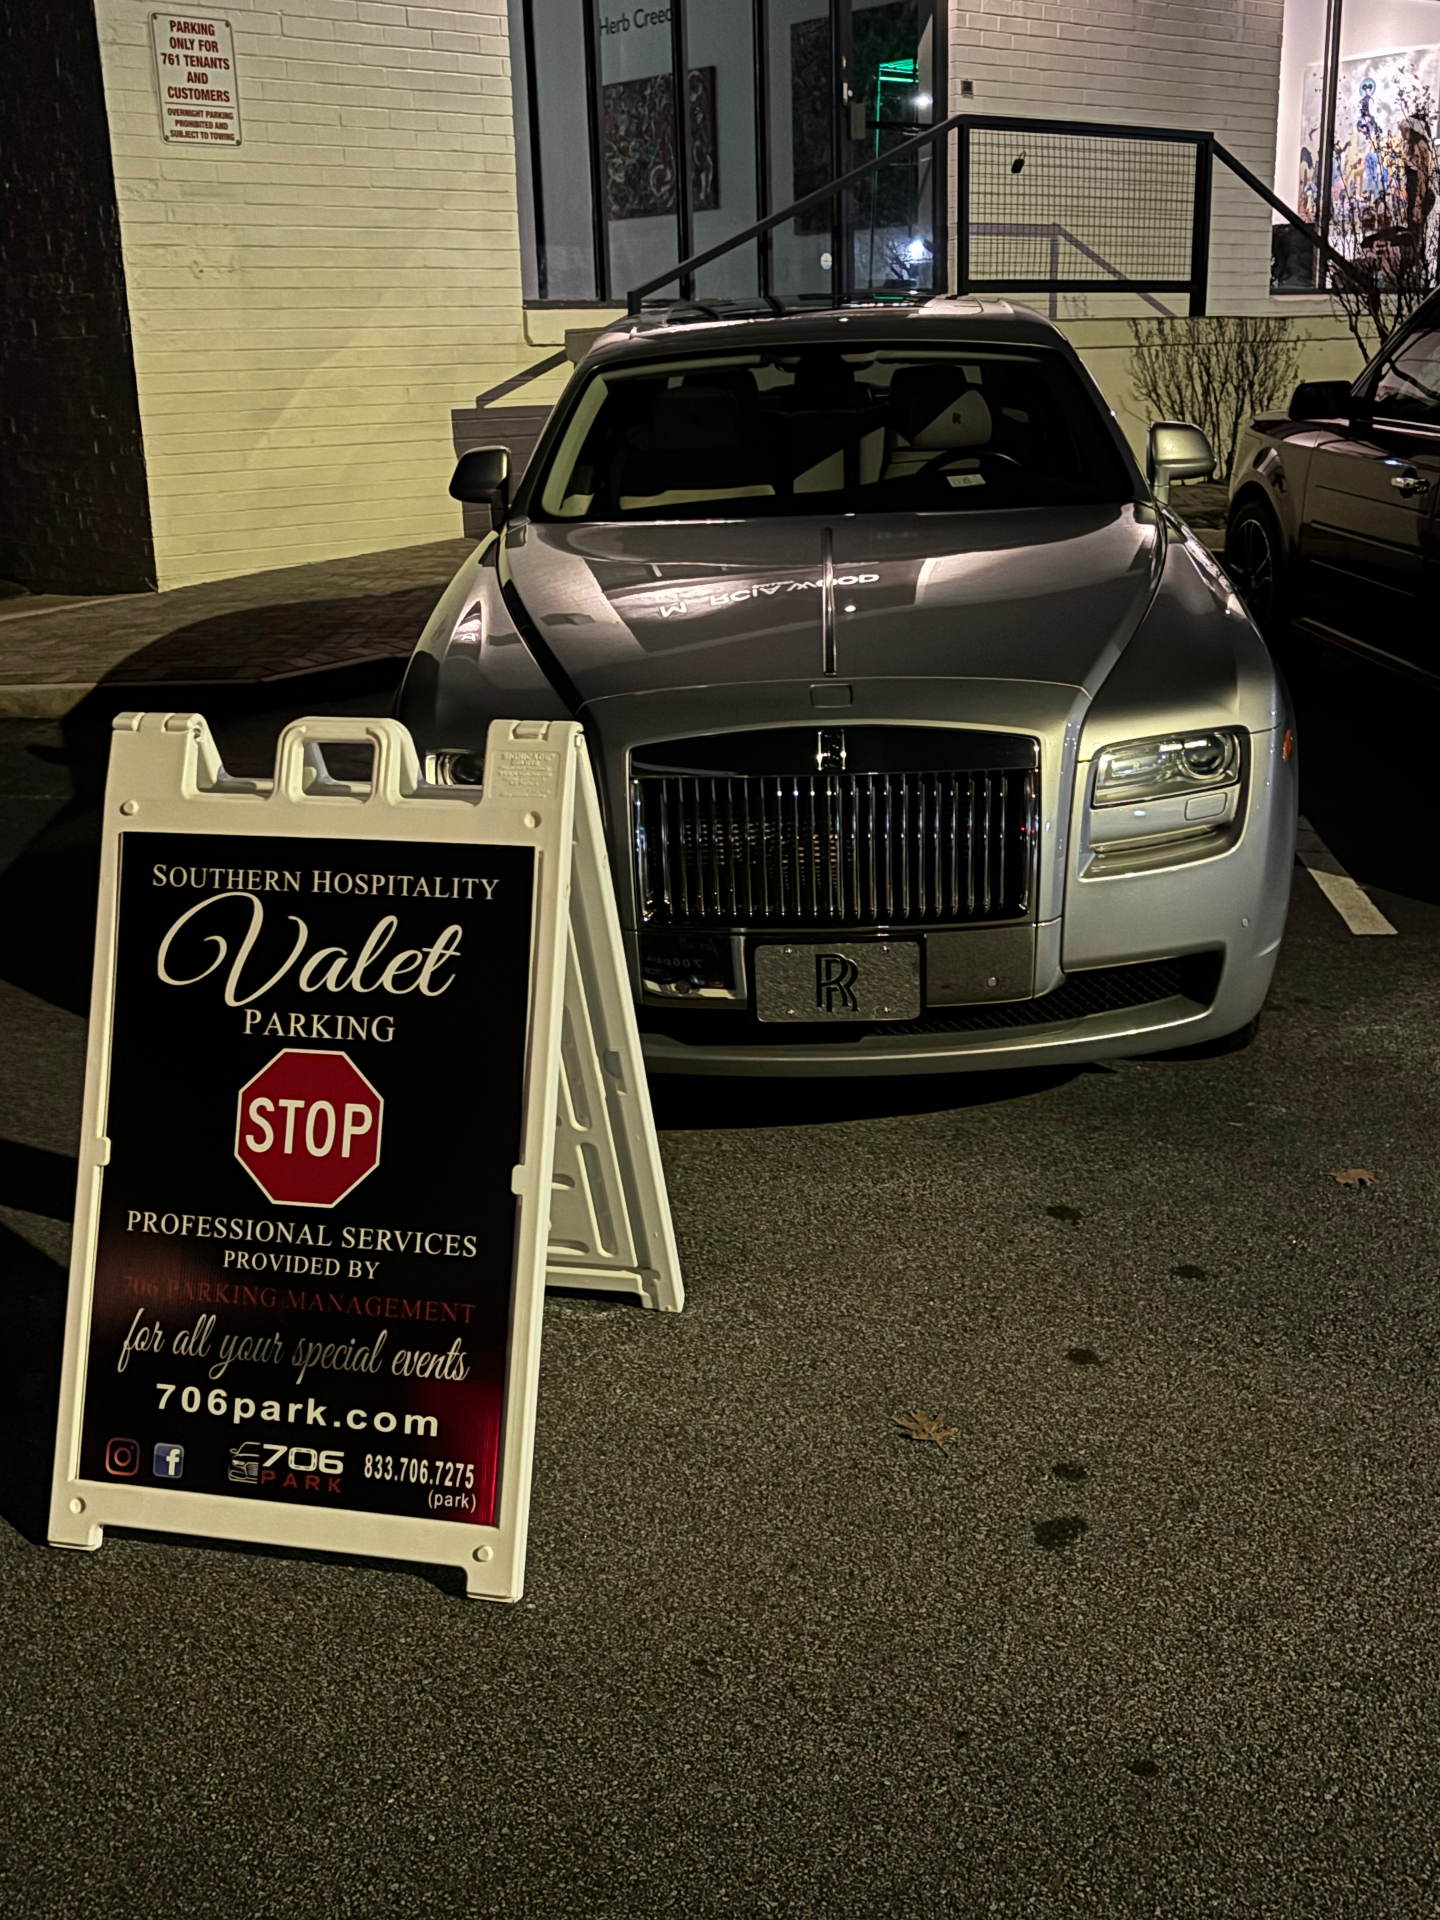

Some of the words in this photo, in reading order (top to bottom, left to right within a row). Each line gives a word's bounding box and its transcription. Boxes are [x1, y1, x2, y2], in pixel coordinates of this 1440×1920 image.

[169, 20, 215, 36] PARKING
[600, 12, 630, 36] Herb
[169, 37, 195, 52] ONLY
[198, 40, 219, 53] FOR
[161, 53, 181, 66] 761
[183, 55, 230, 70] TENANTS
[187, 71, 208, 84] AND
[167, 86, 230, 102] CUSTOMERS
[167, 108, 204, 118] OVERNIGHT
[205, 111, 234, 120] PARKING
[175, 119, 213, 130] PROHIBITED
[215, 122, 229, 130] AND
[170, 130, 199, 140] SUBJECT
[200, 132, 209, 140] TO
[210, 132, 235, 141] TOWING
[152, 864, 302, 892] SOUTHERN
[311, 870, 500, 899] HOSPITALITY
[158, 892, 463, 1007] Valet
[243, 1009, 396, 1042] PARKING
[245, 1097, 373, 1158] STOP
[126, 1210, 332, 1246] PROFESSIONAL
[341, 1226, 478, 1258] SERVICES
[222, 1250, 341, 1276] PROVIDED
[348, 1260, 381, 1279] BY
[123, 1276, 159, 1297] 706
[167, 1278, 277, 1308] PARKING
[285, 1289, 476, 1324] MANAGEMENT
[117, 1308, 166, 1373] for
[172, 1313, 217, 1358] all
[208, 1331, 284, 1380] your
[291, 1329, 388, 1385] special
[391, 1337, 470, 1382] events
[155, 1383, 439, 1437] 706park.com
[263, 1443, 345, 1475] 706
[364, 1453, 475, 1489] 833.706.7275
[260, 1470, 342, 1493] PARK
[428, 1489, 477, 1514] (park)
